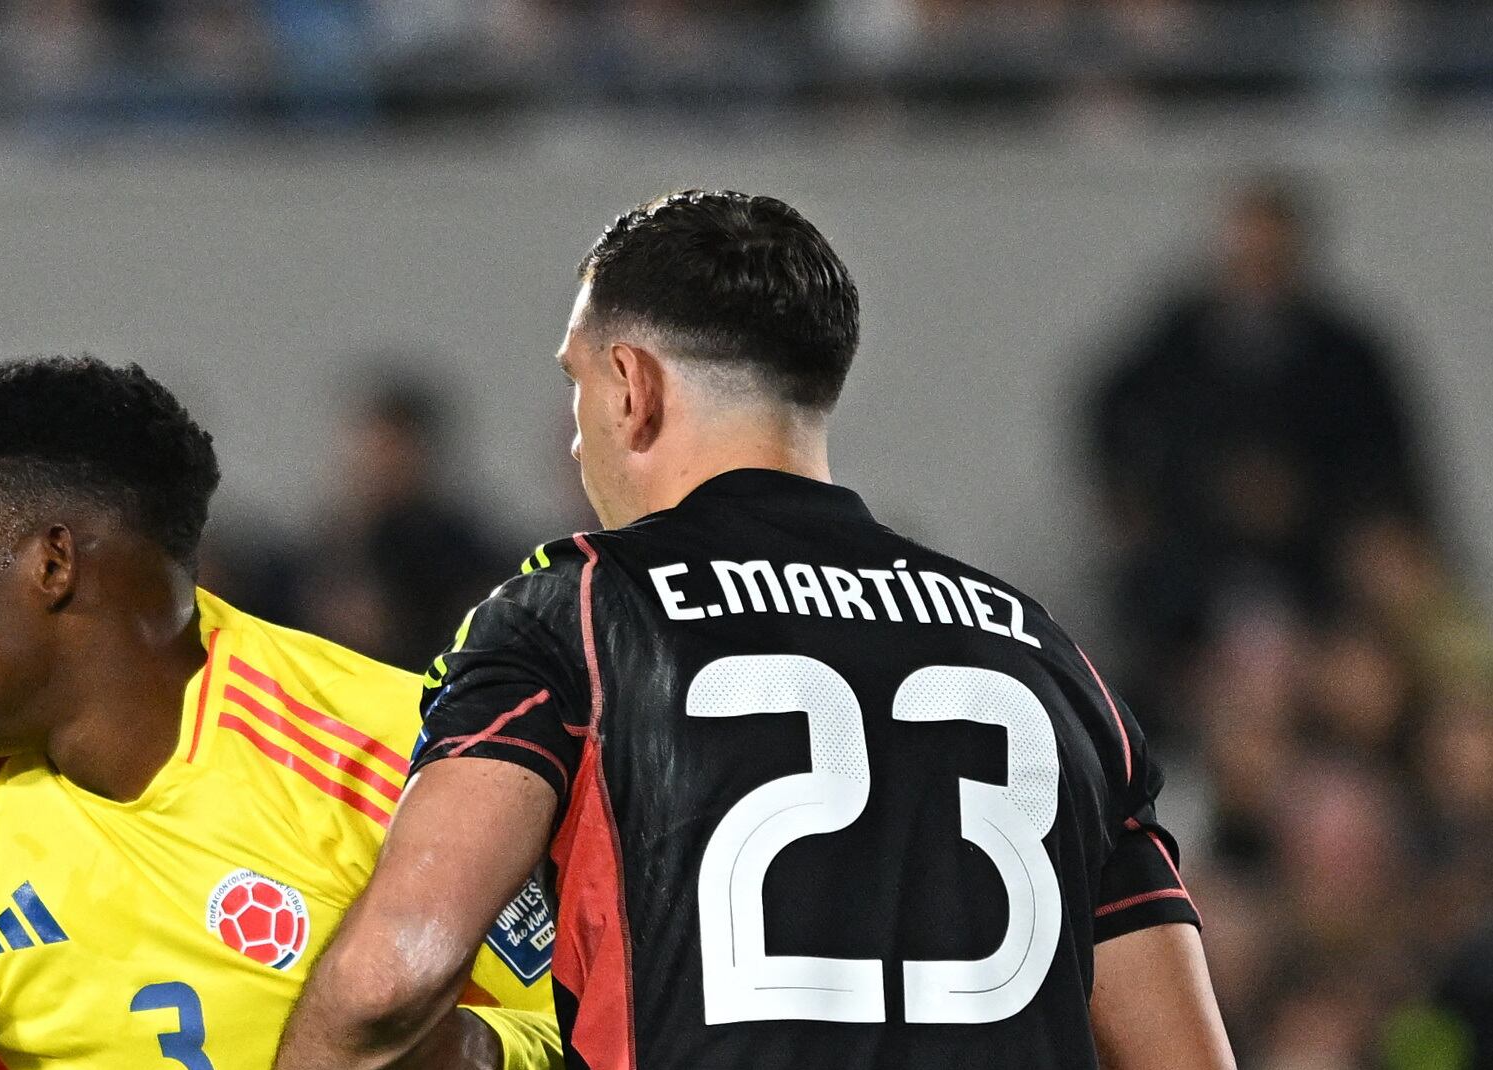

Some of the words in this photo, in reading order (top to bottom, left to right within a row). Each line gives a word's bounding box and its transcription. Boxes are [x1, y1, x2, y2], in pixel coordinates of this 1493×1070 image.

[648, 558, 1042, 649] E.MARTÍNEZ
[686, 654, 1063, 1026] 23
[496, 882, 543, 931] UNITES
[506, 928, 528, 947] the
[535, 926, 556, 946] FIFA
